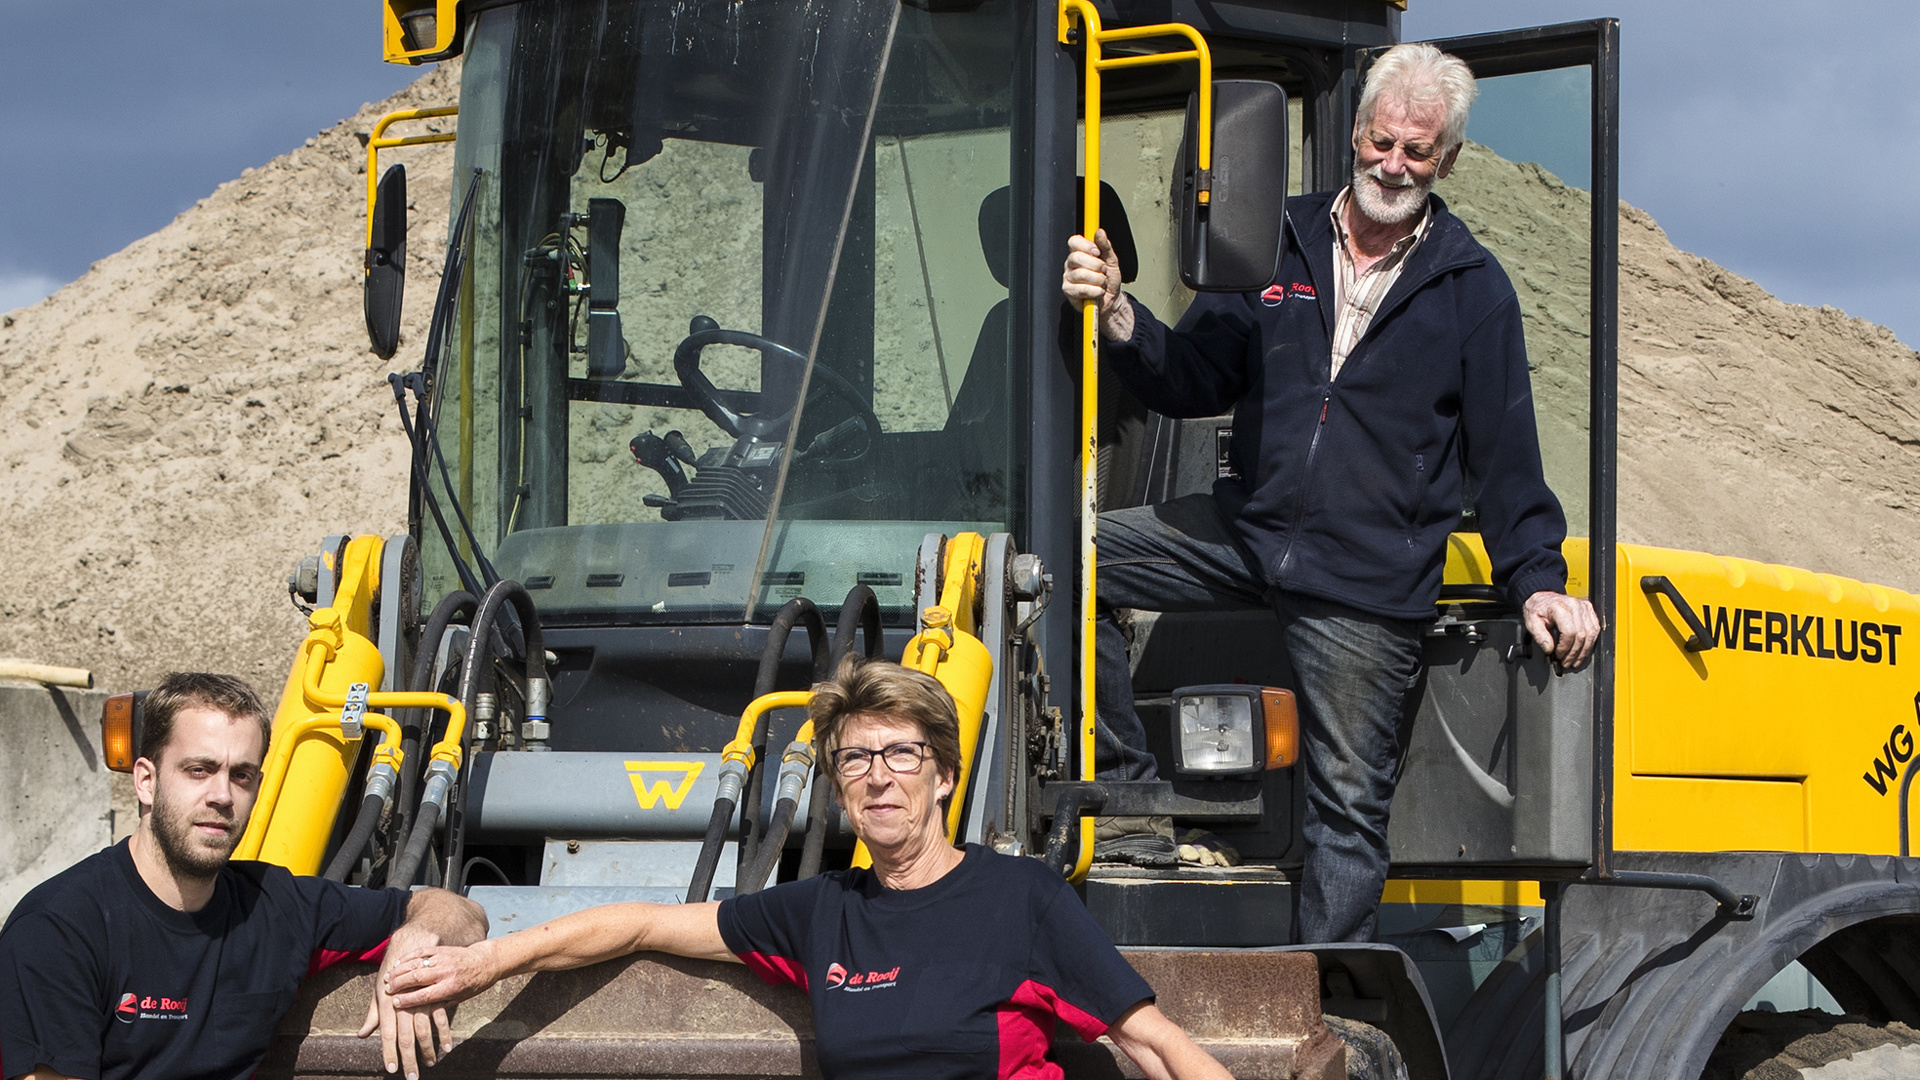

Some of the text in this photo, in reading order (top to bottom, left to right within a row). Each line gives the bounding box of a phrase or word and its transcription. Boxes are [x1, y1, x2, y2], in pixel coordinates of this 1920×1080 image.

[1702, 604, 1902, 666] WERKLUST
[1862, 724, 1914, 797] WG
[848, 966, 901, 985] de Rooij
[140, 996, 158, 1009] de
